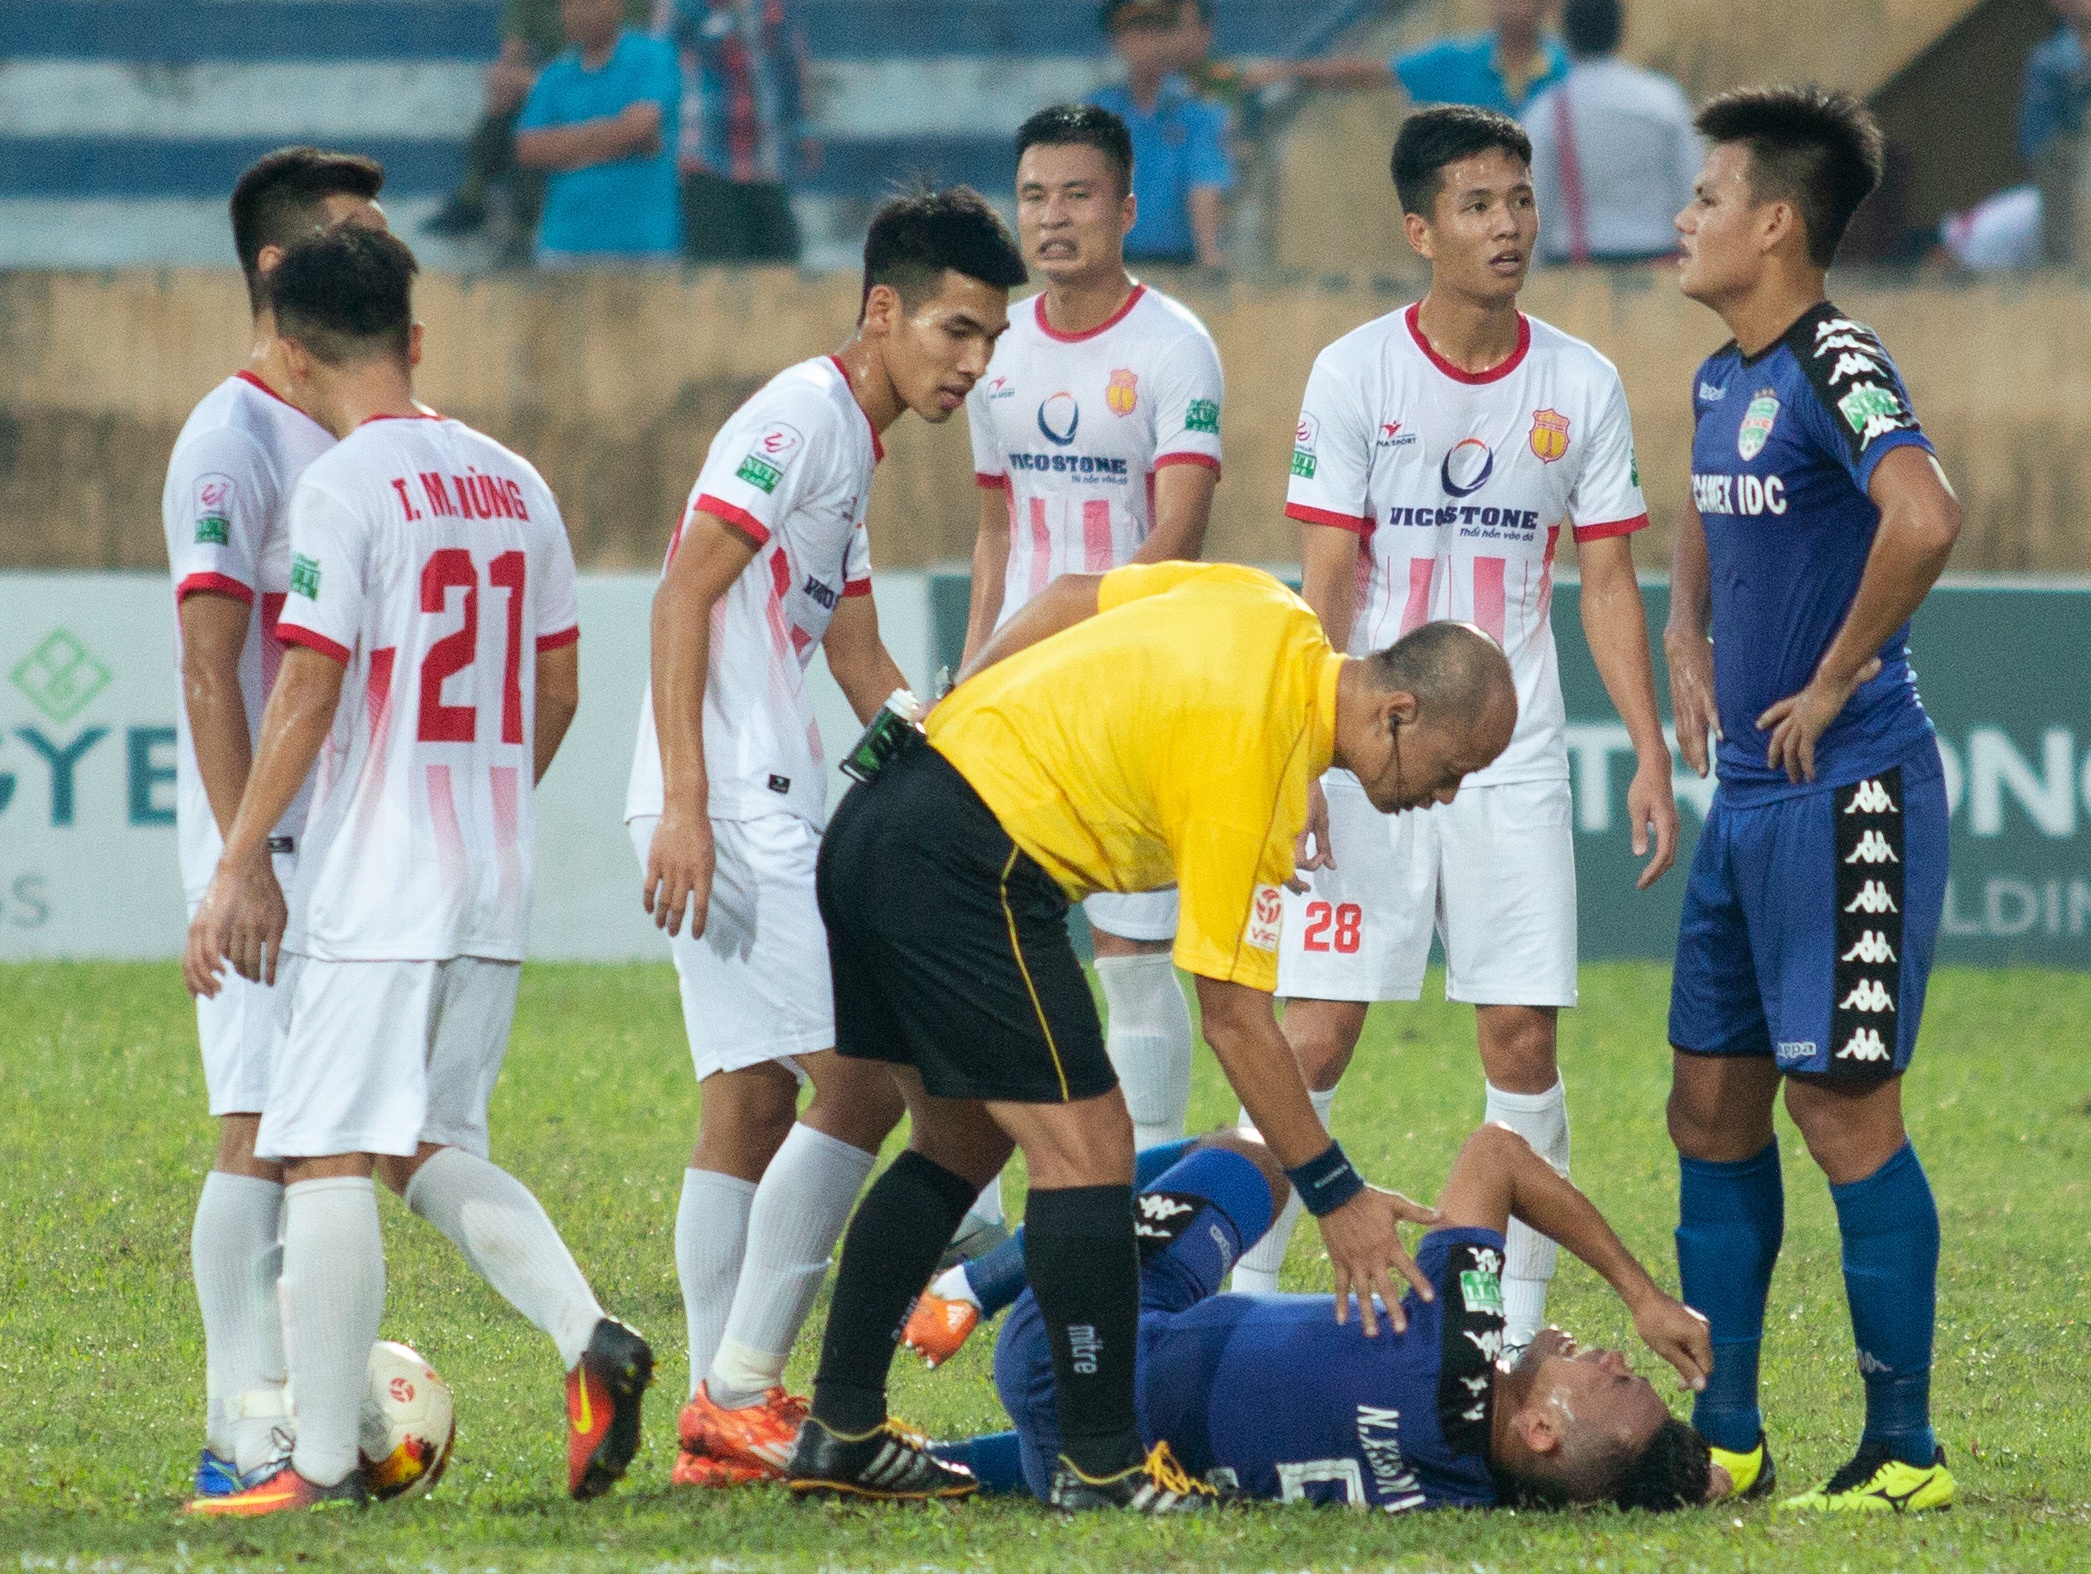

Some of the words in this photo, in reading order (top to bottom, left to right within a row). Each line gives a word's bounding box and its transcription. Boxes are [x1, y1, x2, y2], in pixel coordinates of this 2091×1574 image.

[1389, 506, 1539, 530] VICOSTONE
[1738, 474, 1787, 515] IDC
[416, 548, 525, 745] 21
[1303, 901, 1362, 954] 28
[1067, 1325, 1104, 1374] mitre
